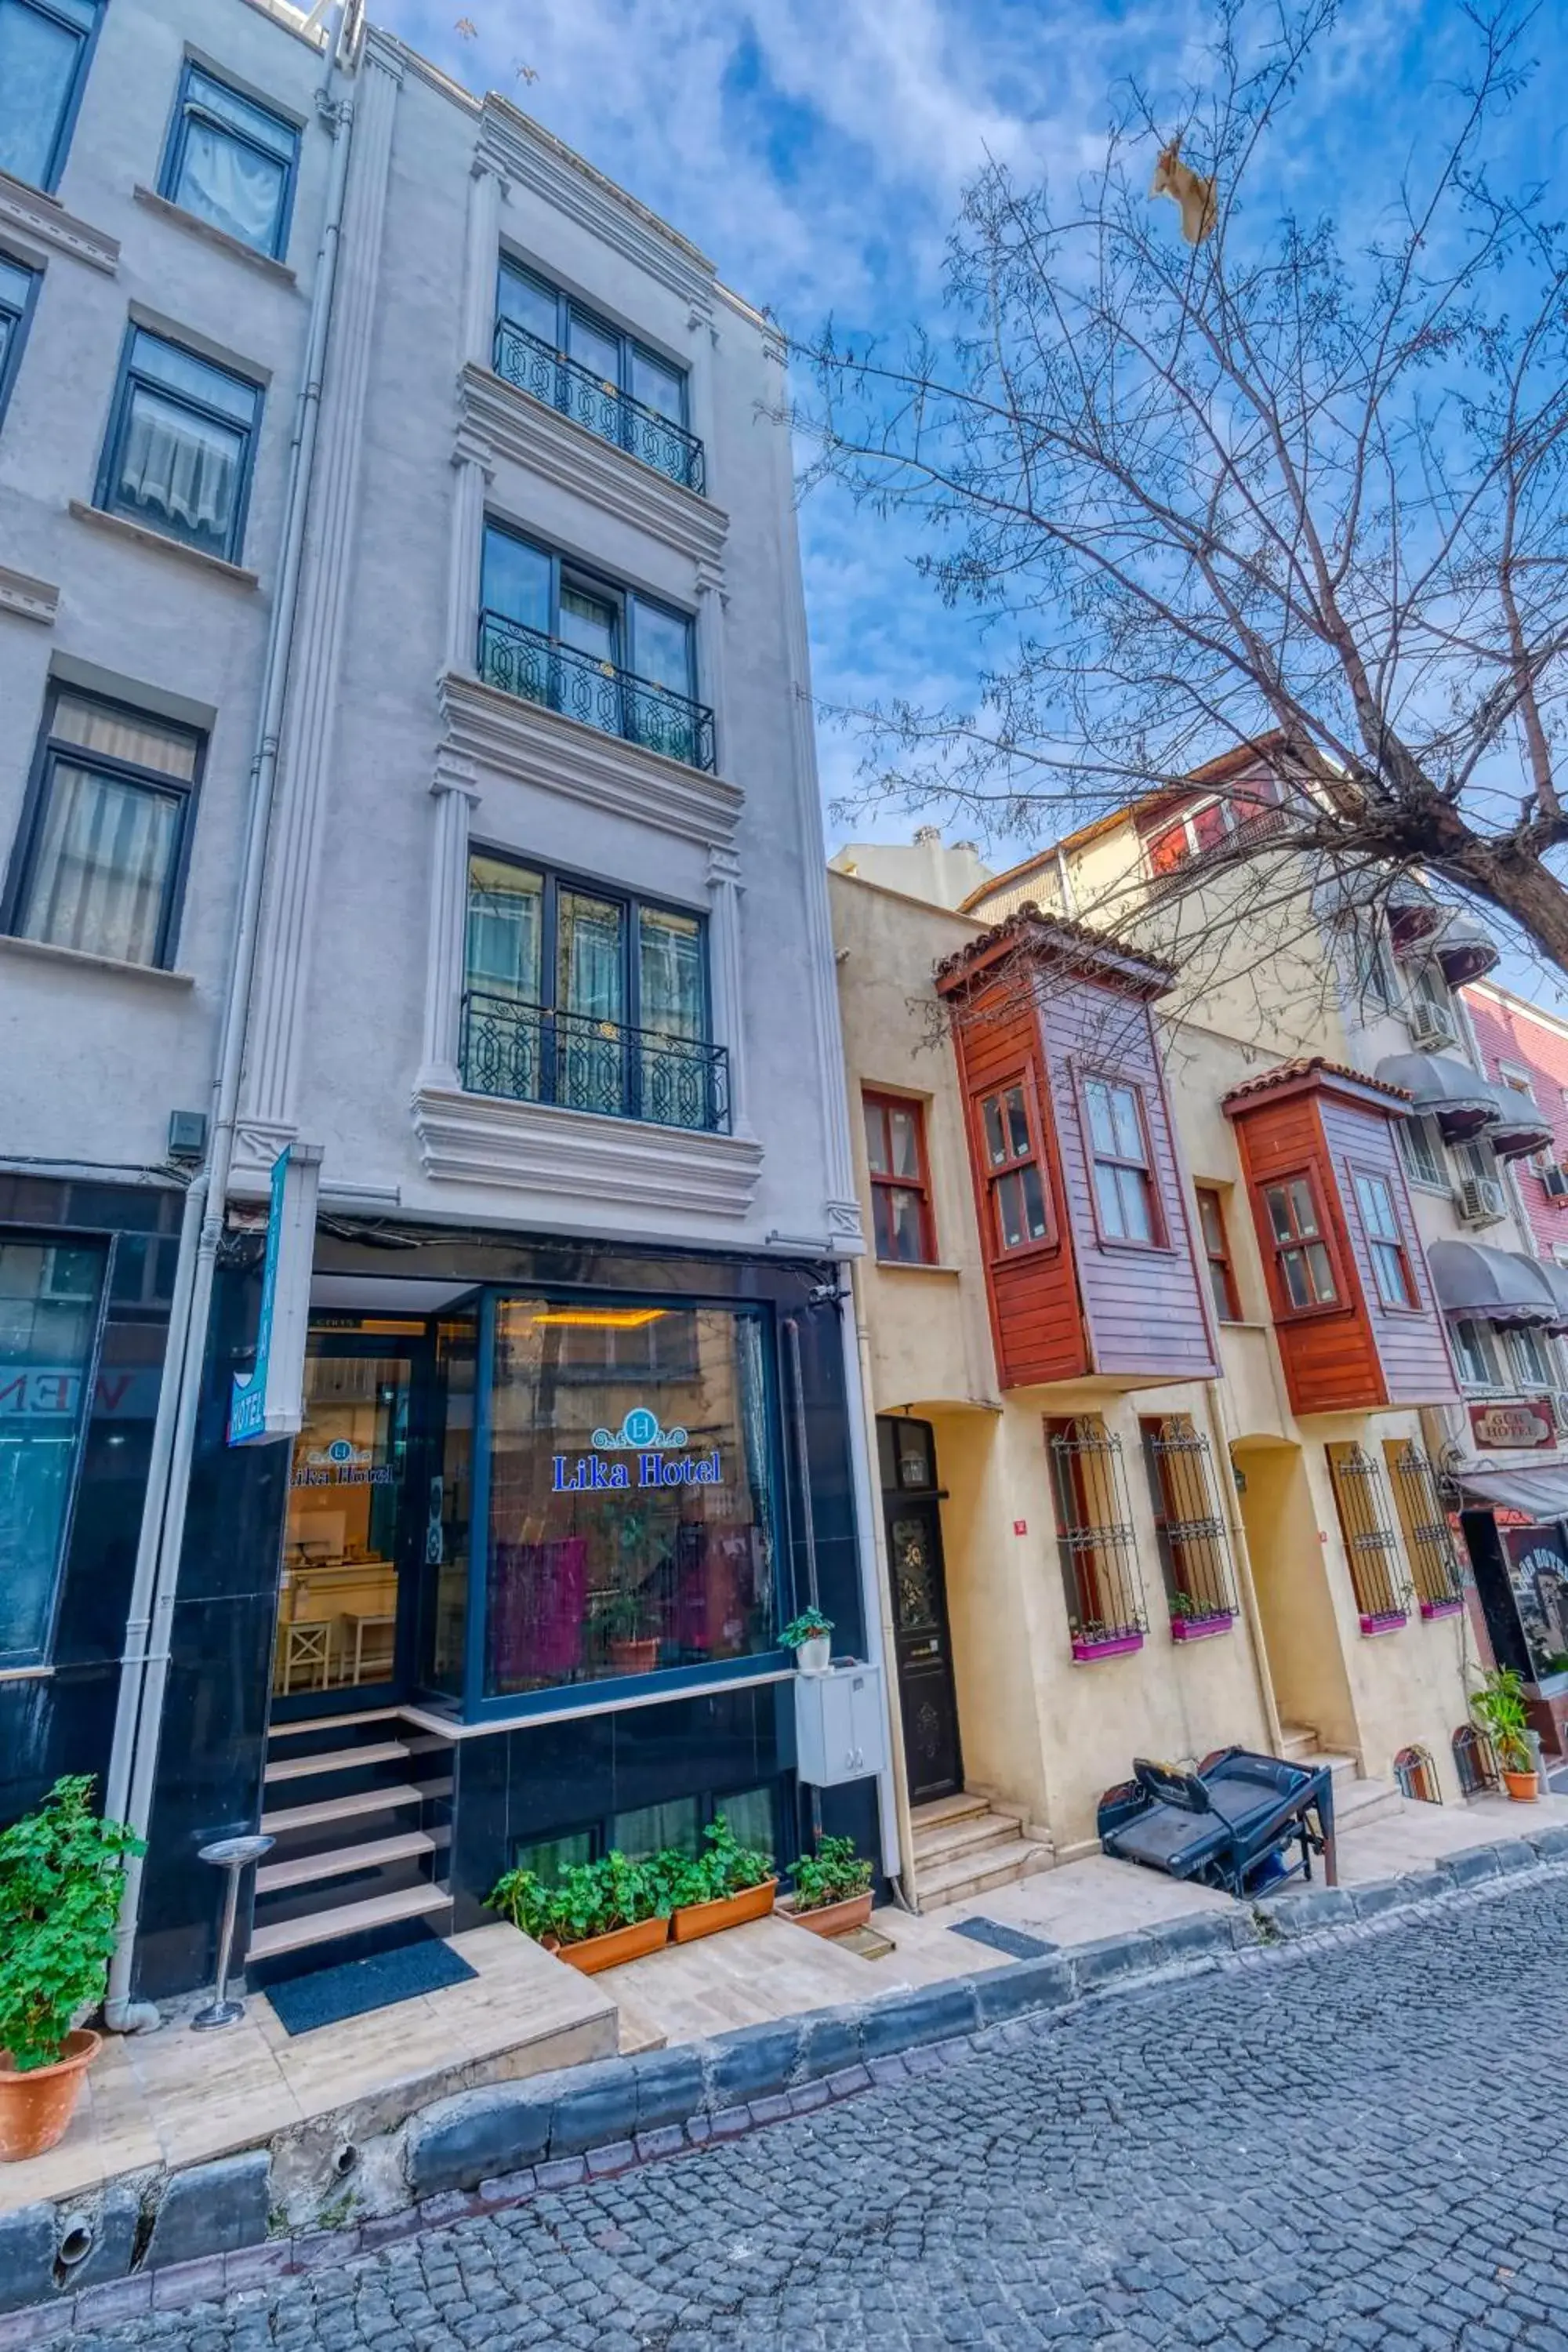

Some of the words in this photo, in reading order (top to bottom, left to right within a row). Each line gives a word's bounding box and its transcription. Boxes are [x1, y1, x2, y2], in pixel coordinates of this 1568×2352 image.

[338, 1465, 394, 1485] Hotel
[552, 1455, 630, 1491] Lika
[638, 1451, 724, 1487] Hotel
